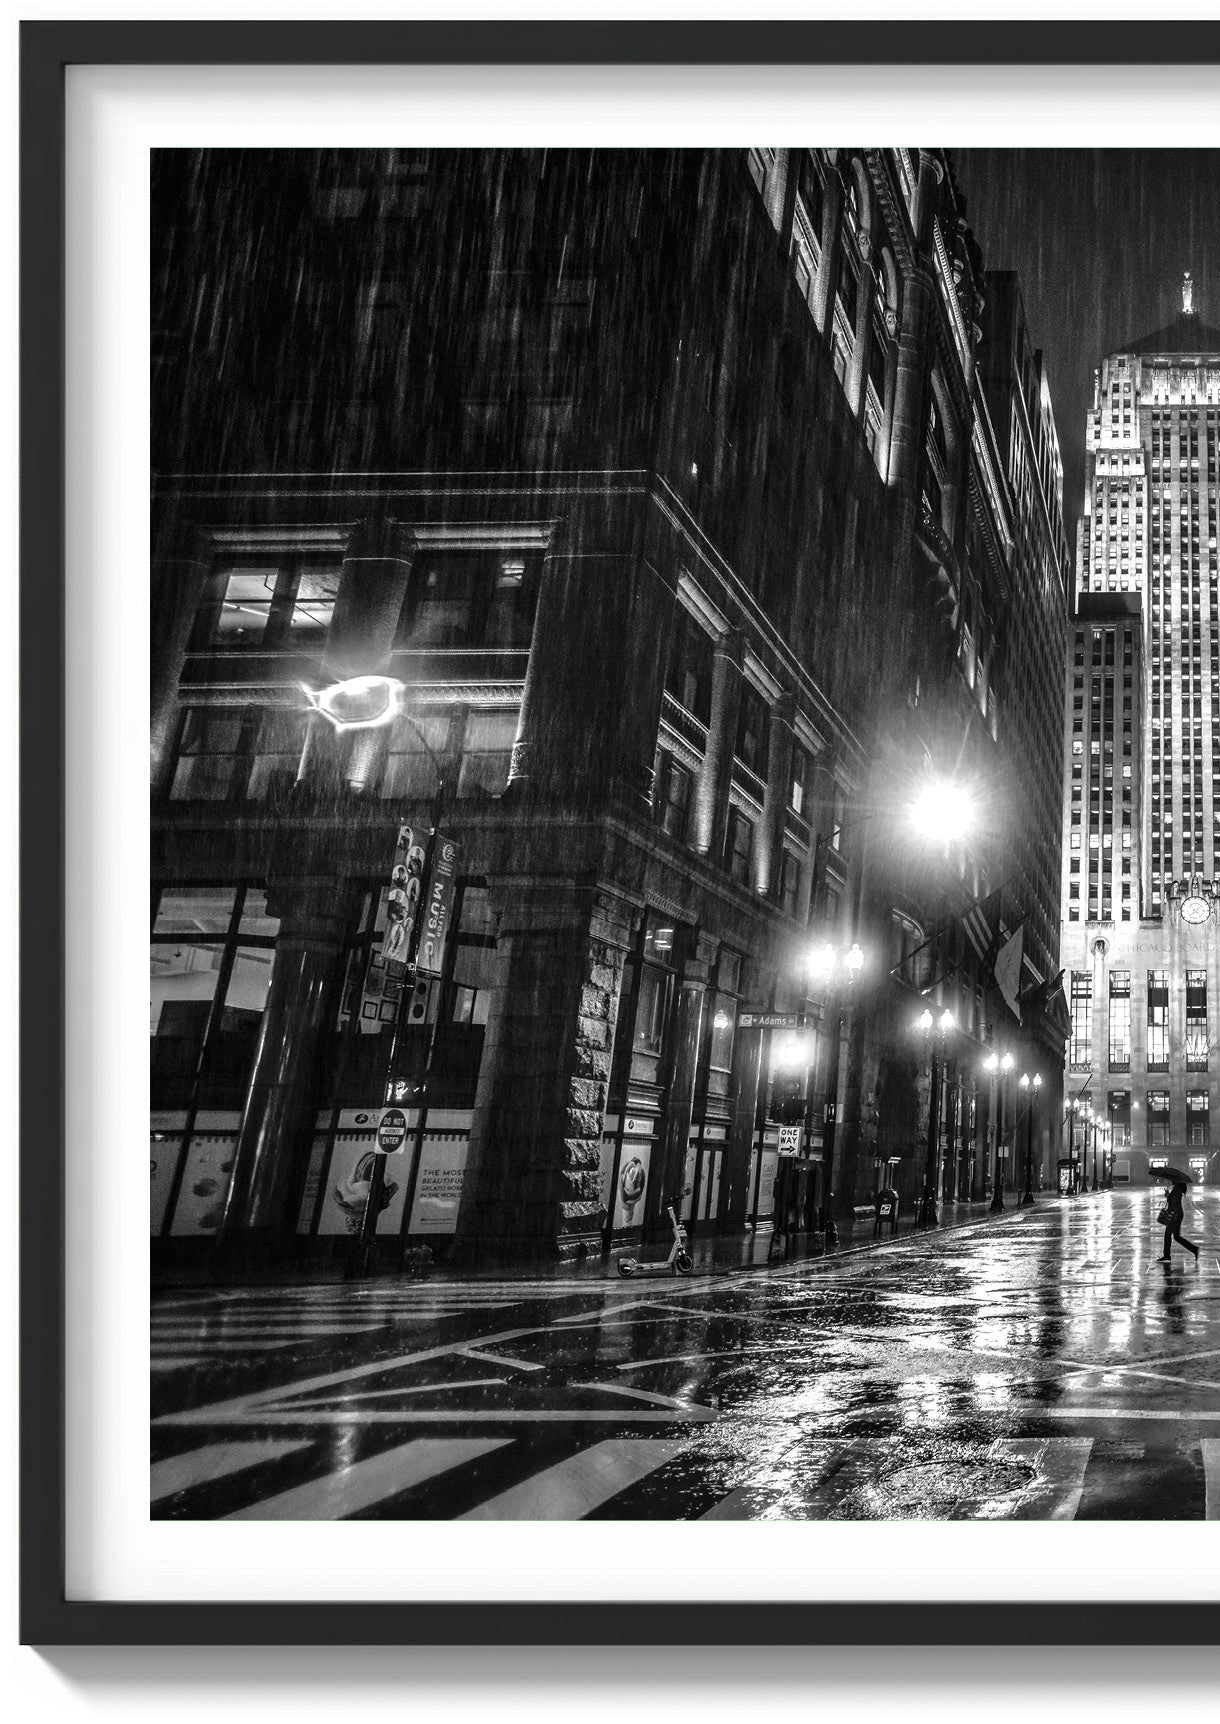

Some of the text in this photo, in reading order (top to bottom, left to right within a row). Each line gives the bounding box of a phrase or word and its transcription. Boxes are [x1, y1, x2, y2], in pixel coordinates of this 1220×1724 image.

[424, 882, 444, 955] MUSIC
[1117, 942, 1172, 952] CHICAGO
[1178, 942, 1214, 953] BOARD
[759, 1016, 787, 1025] Adams
[383, 1117, 392, 1125] DO
[393, 1117, 405, 1126] NOT
[382, 1136, 399, 1145] ENTER
[780, 1136, 798, 1144] WAY
[421, 1177, 464, 1185] BEAUTIFUL
